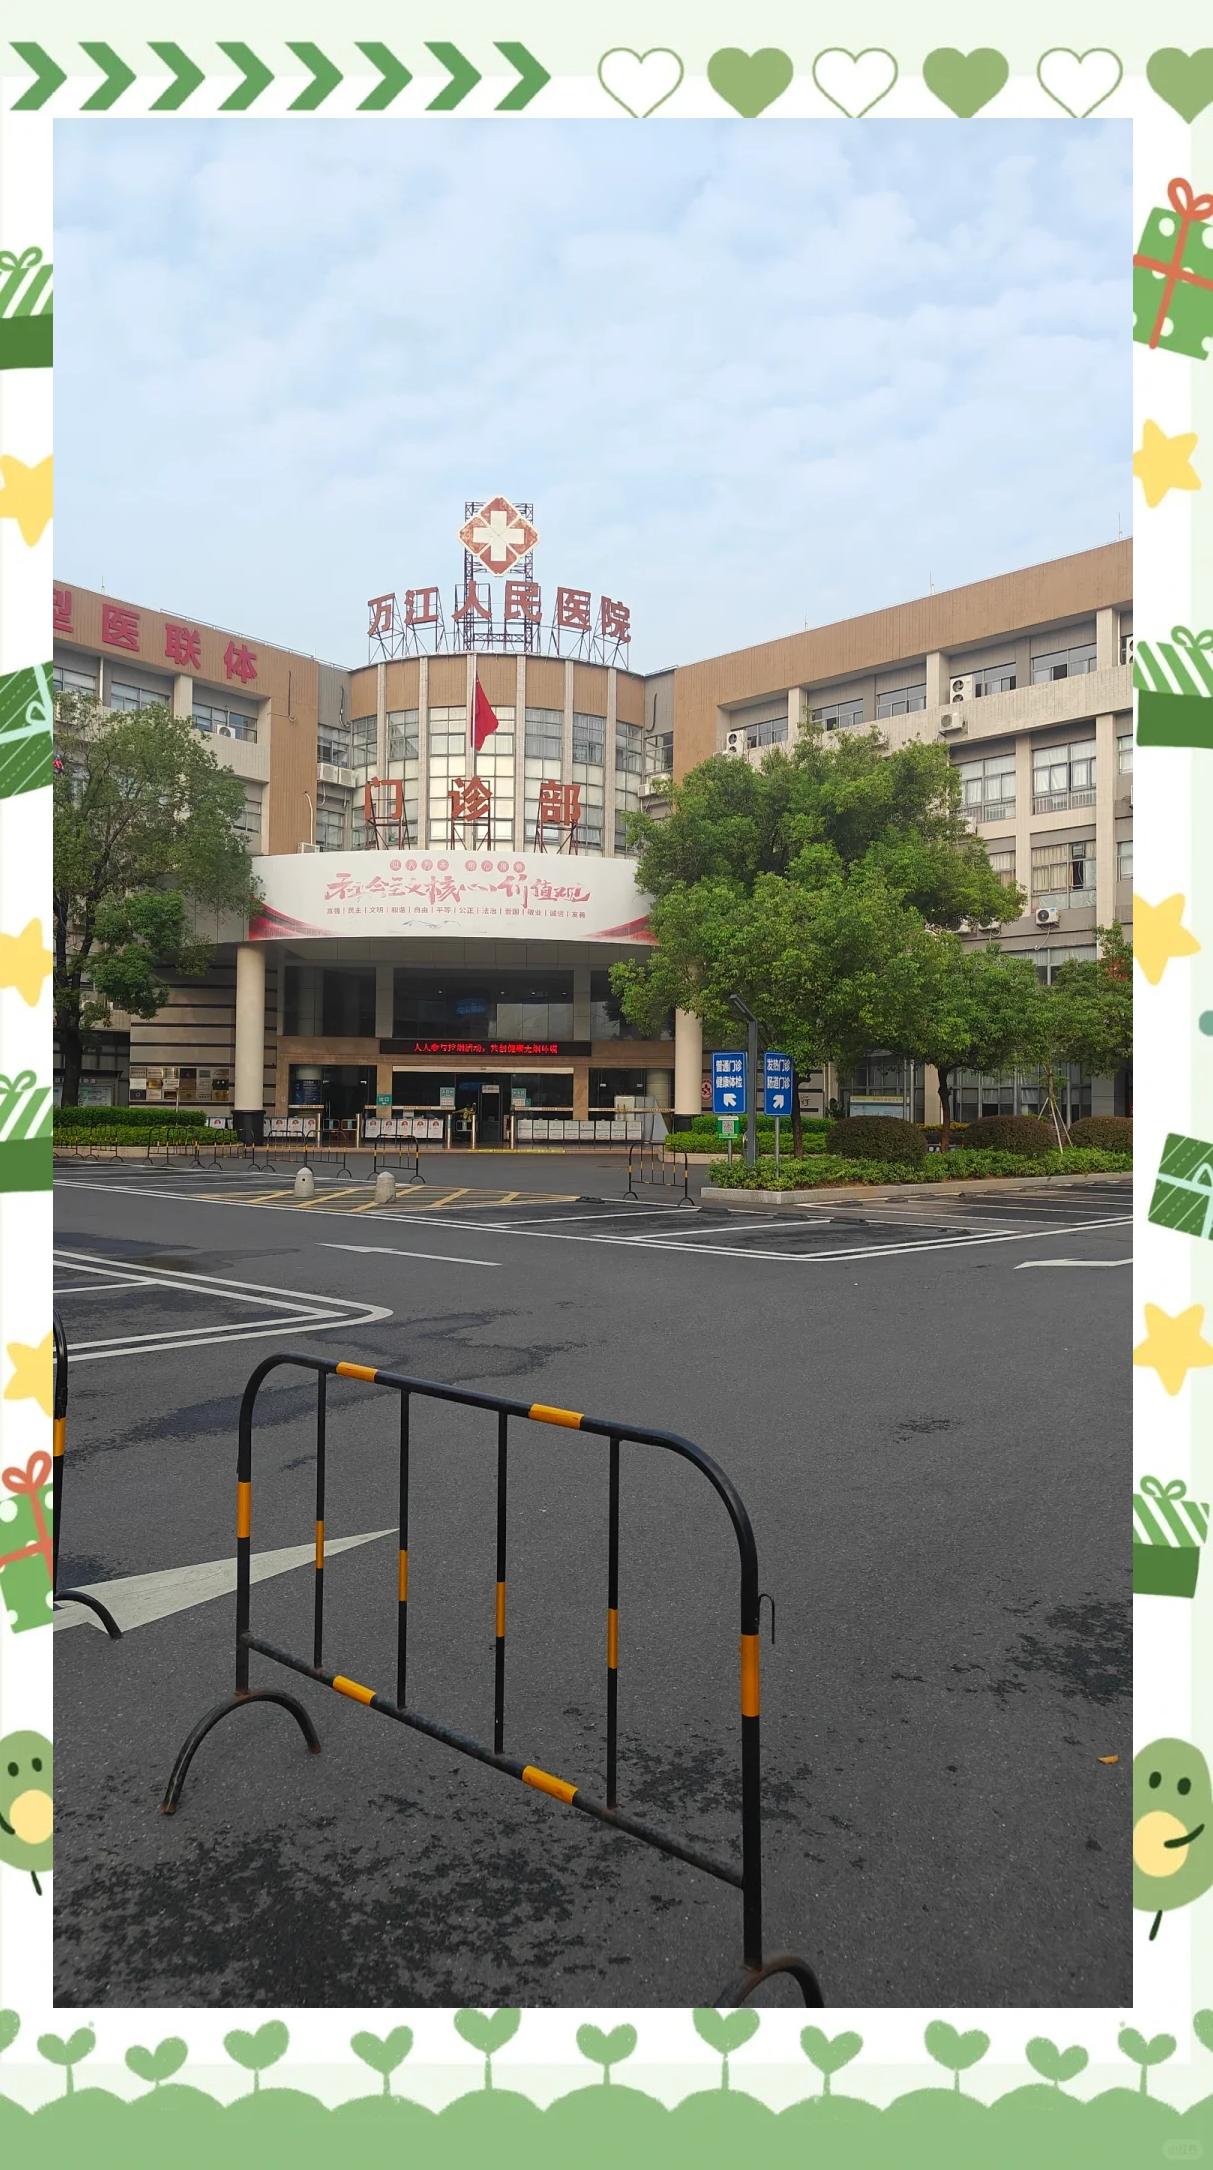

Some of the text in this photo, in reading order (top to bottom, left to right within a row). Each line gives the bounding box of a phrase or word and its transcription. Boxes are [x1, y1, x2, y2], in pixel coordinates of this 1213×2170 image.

[367, 580, 632, 643] 万江人民医院
[364, 775, 581, 826] 门诊部
[324, 873, 591, 909] 社会主义核心价值观
[716, 1059, 743, 1072] 普通门诊
[767, 1058, 791, 1072] 发热门诊
[716, 1075, 743, 1088] 健康体检
[767, 1076, 791, 1089] 肠道门诊
